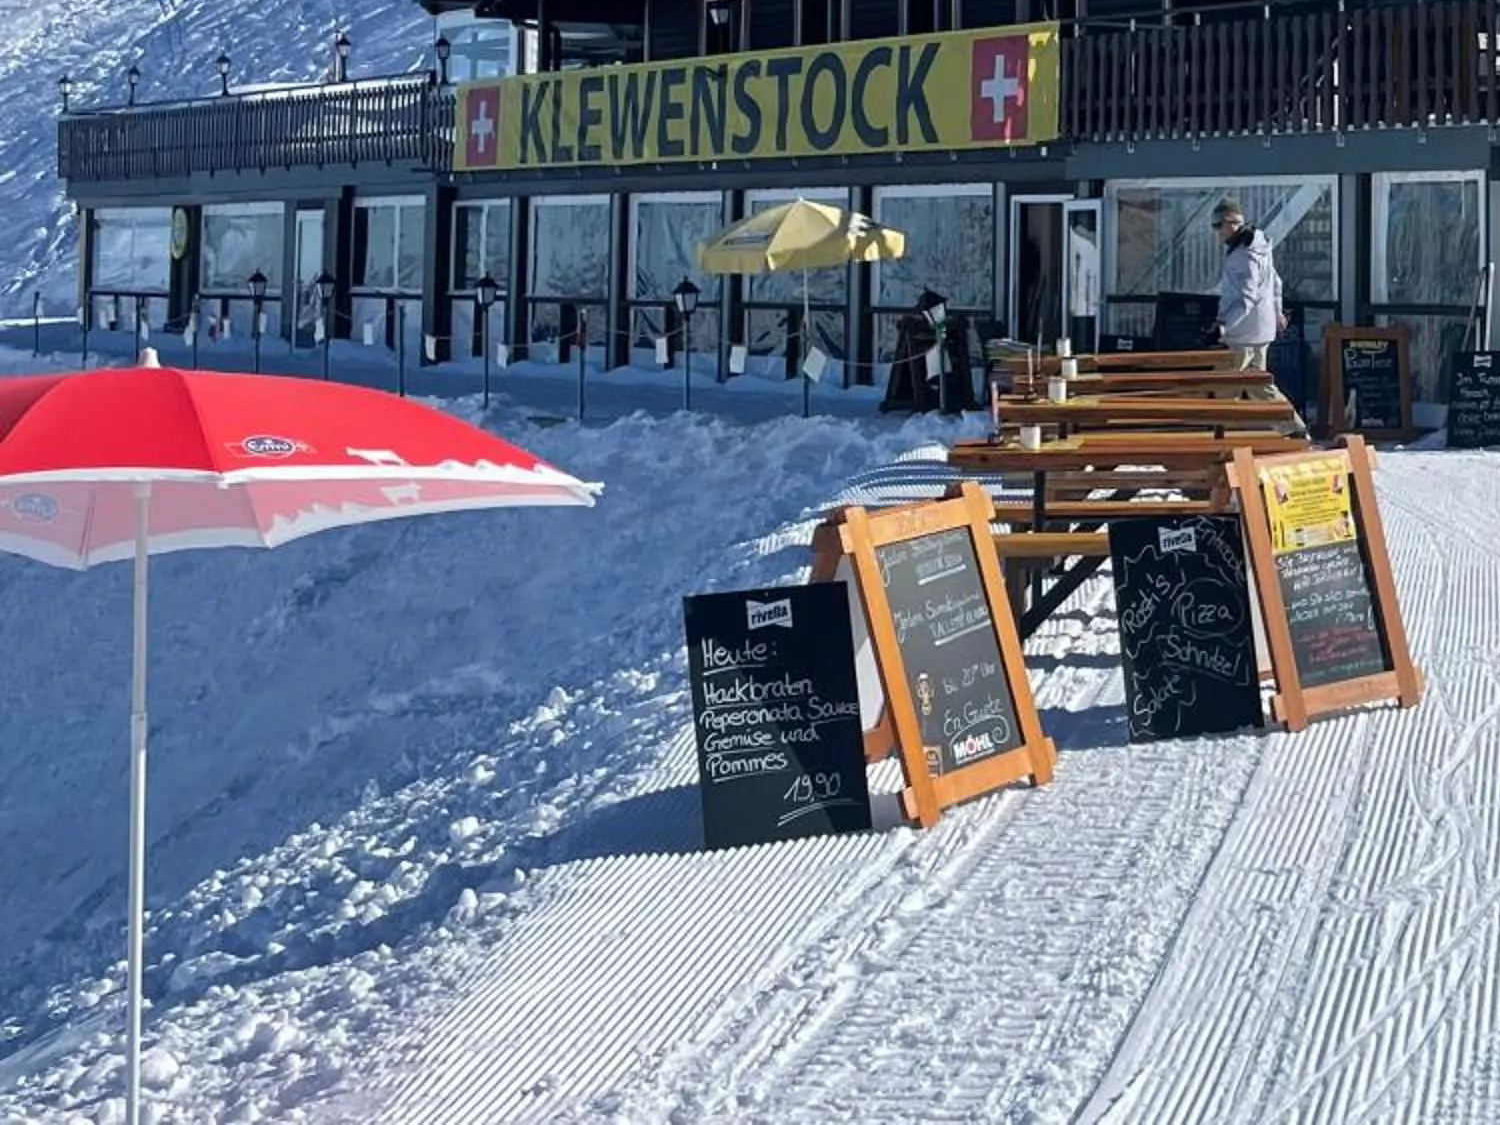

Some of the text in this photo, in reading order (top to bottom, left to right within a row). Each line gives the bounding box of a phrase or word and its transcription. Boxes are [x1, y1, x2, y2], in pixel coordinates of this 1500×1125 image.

[518, 41, 942, 165] KLEWENSTOCK
[1171, 592, 1233, 627] Pizza
[703, 673, 813, 704] Hackbraten
[781, 724, 819, 743] und
[706, 753, 788, 777] Pommes
